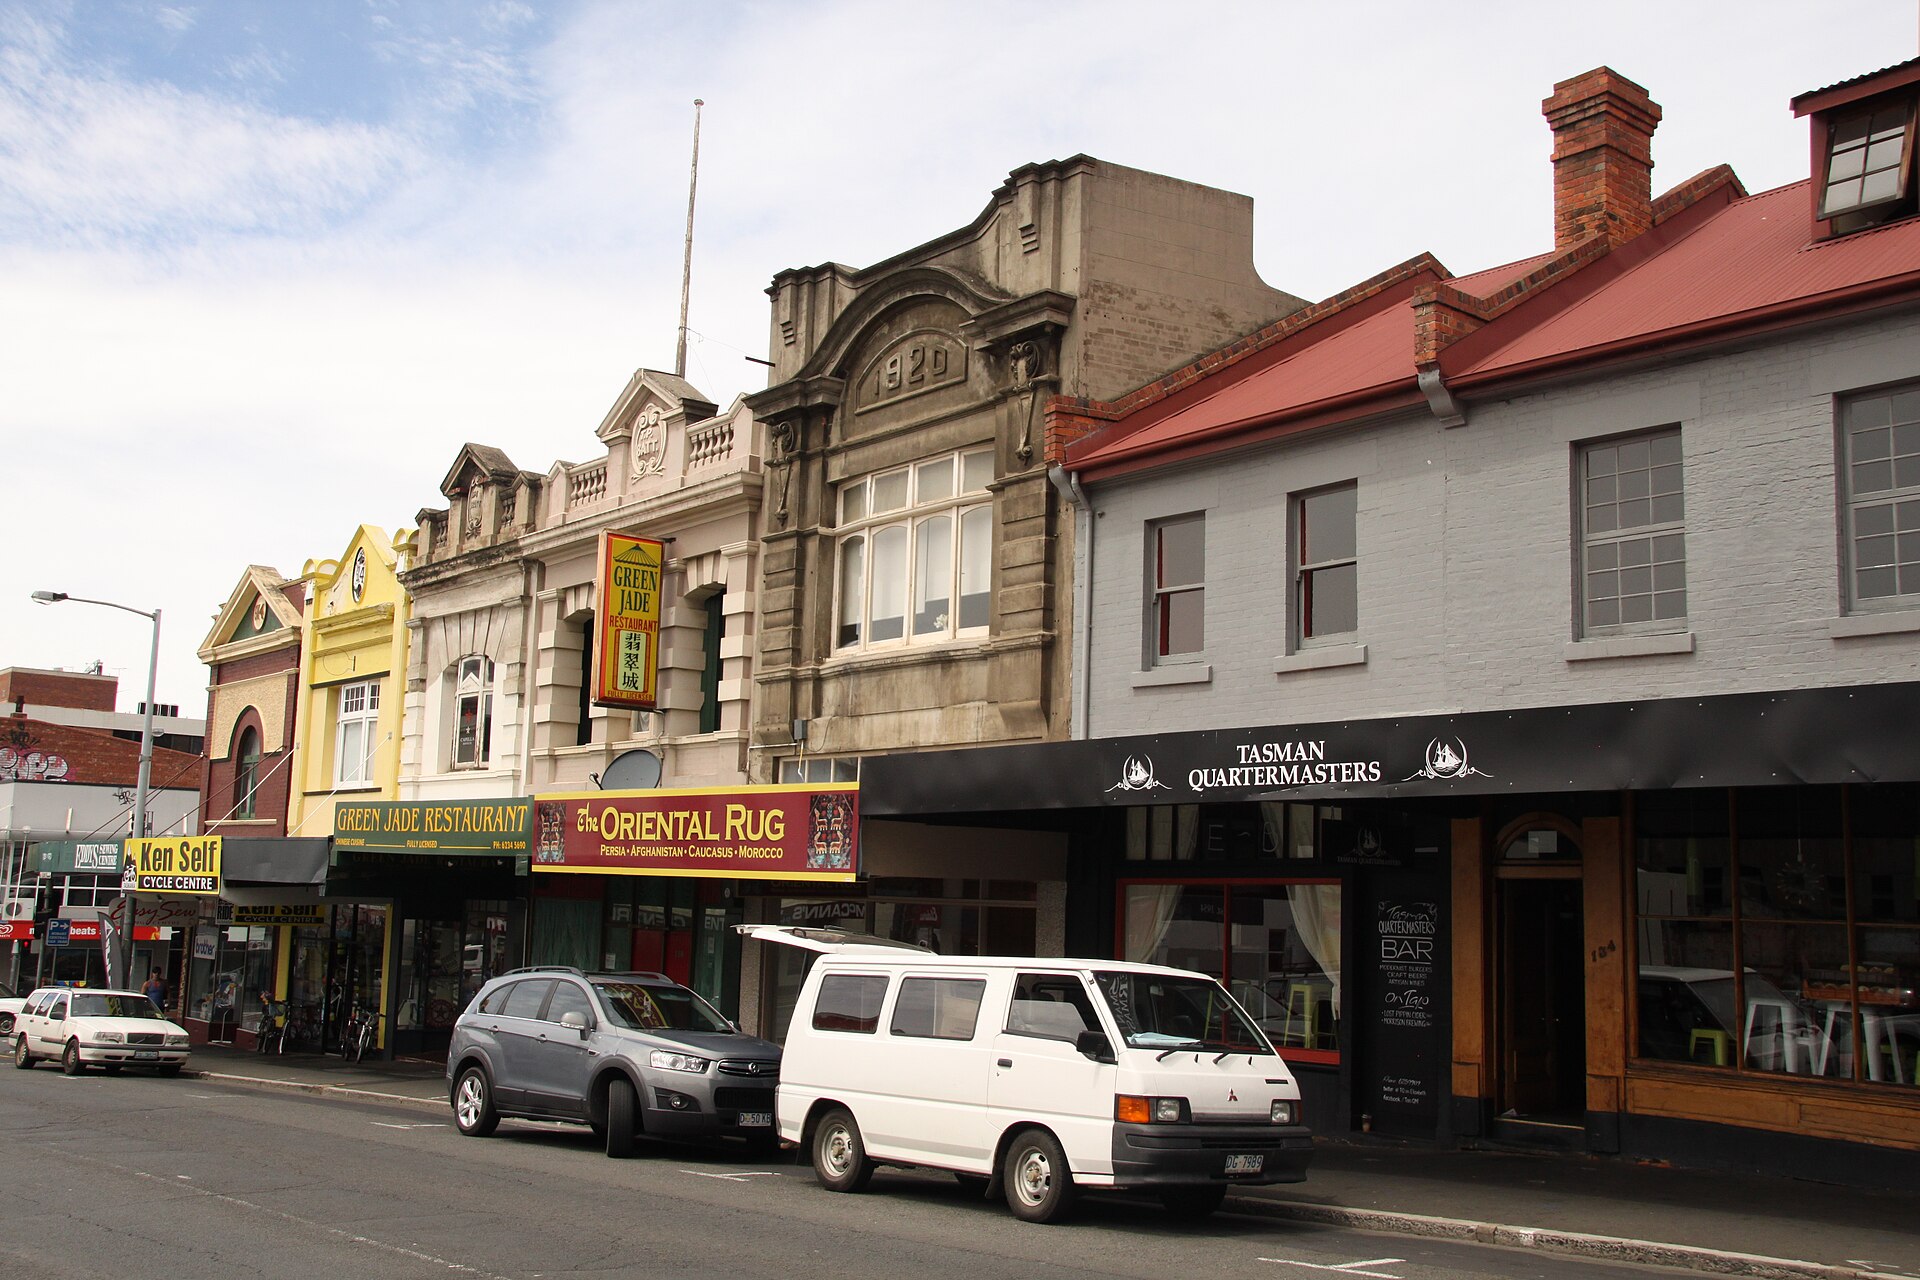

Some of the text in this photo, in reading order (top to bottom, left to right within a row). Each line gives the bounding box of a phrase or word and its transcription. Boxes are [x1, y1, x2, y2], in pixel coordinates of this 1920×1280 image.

[874, 343, 947, 396] 1920
[612, 565, 658, 593] GREEN
[618, 589, 650, 615] JADE
[609, 616, 658, 634] RESTAURANT
[622, 633, 641, 691] 翡翠城
[1236, 740, 1325, 765] TASMAN
[1187, 761, 1380, 791] QUARTERMASTERS
[337, 805, 528, 832] GREEN JADE RESTAURANT
[576, 802, 786, 841] The ORIENTAL RUG
[99, 844, 118, 854] SEWING
[351, 838, 365, 847] CUISINE
[406, 840, 437, 849] FULLY LICENSED
[493, 841, 526, 850] PH: 6234 5690
[600, 844, 783, 859] PERSIA AFGHANISTAN CAUCASUS MOROCCO
[98, 855, 117, 866] CENTRE
[140, 841, 217, 872] Ken Self
[143, 877, 173, 889] CYCLE
[175, 877, 212, 890] CENTRE
[50, 921, 59, 930] P
[1378, 920, 1436, 935] QUARTERMASTERS
[1381, 939, 1433, 961] BAR
[1384, 989, 1429, 1010] On Tap
